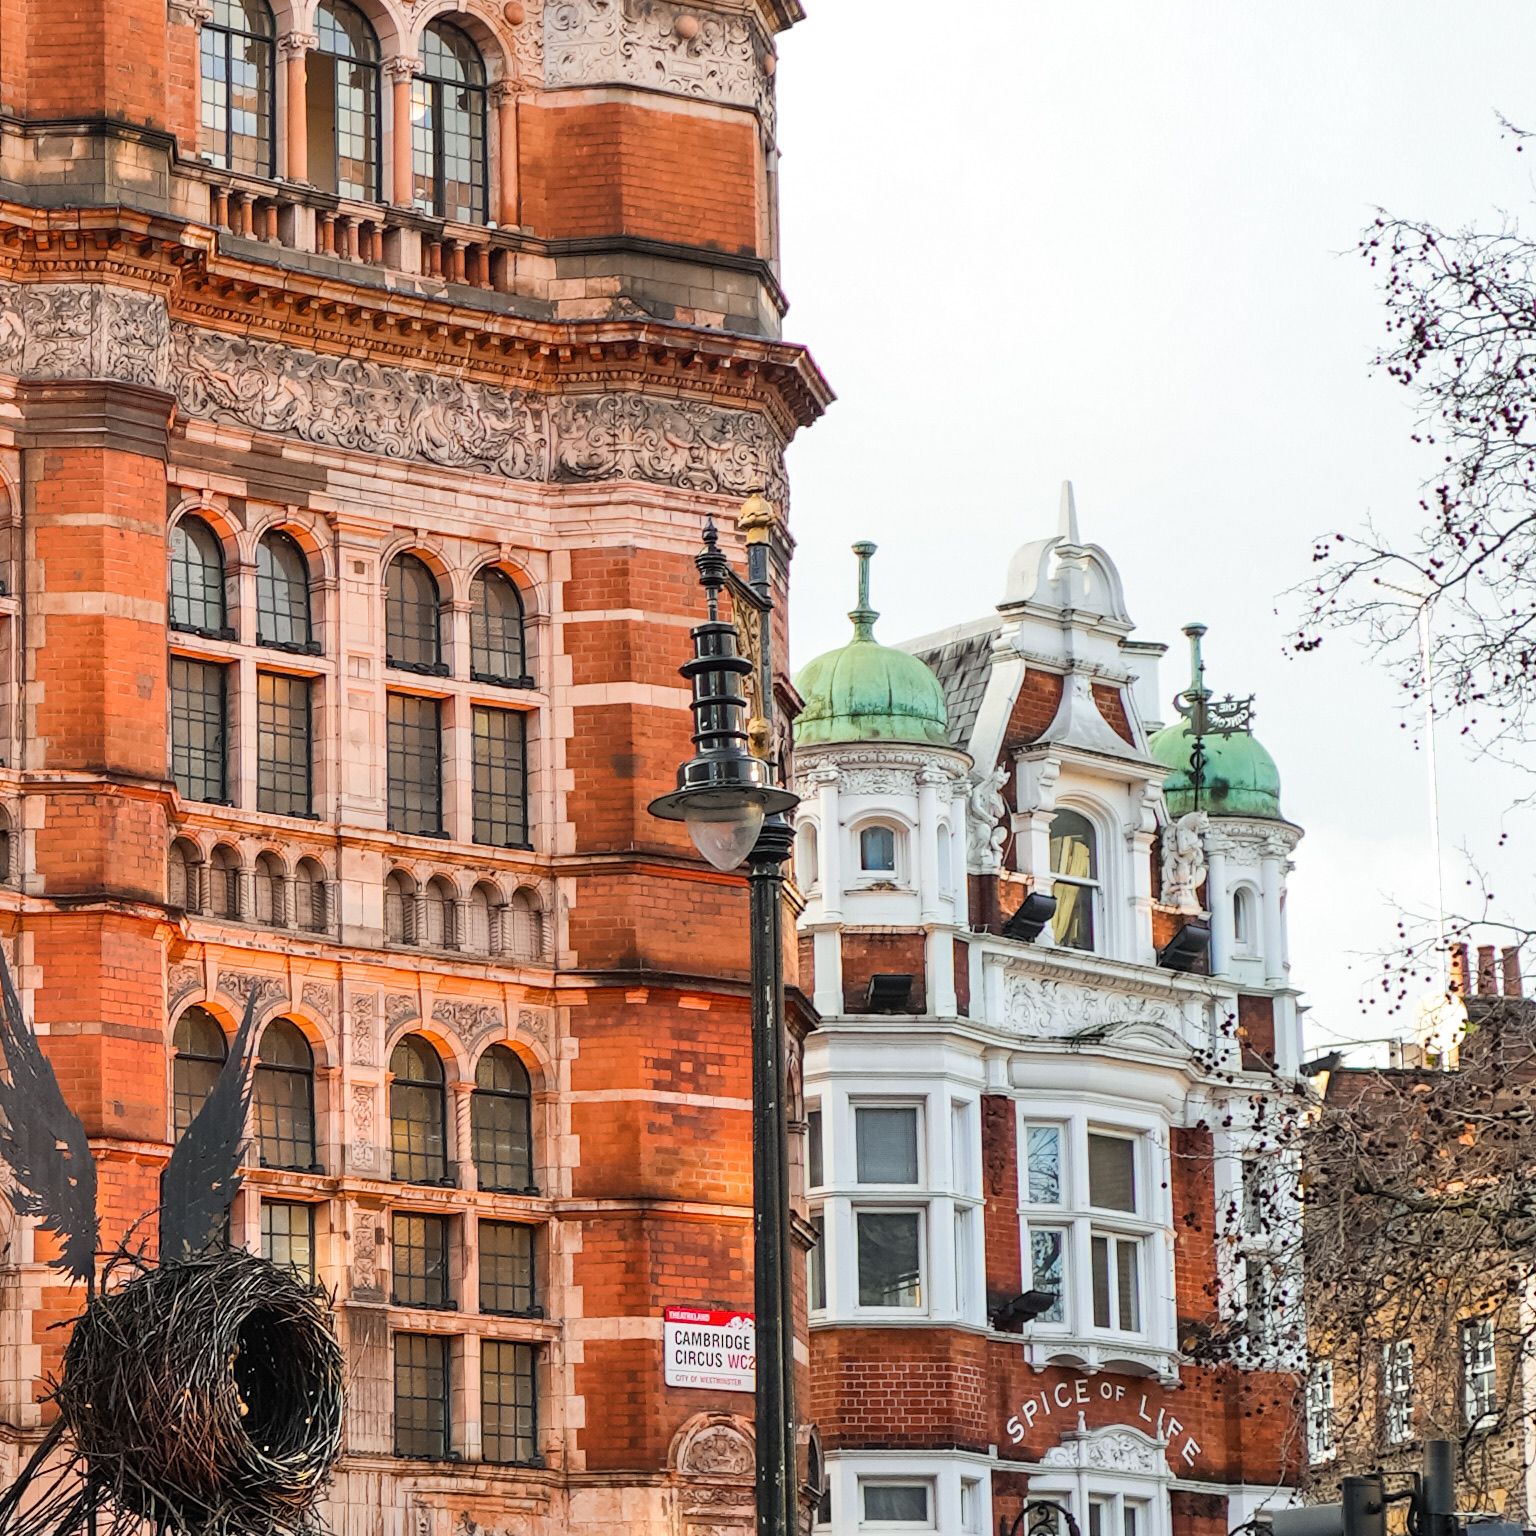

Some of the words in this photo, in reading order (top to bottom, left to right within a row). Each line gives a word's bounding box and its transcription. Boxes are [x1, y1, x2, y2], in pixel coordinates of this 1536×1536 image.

[675, 1330, 751, 1351] CAMBRIDGE
[675, 1349, 723, 1368] CIRCUS
[728, 1354, 756, 1371] WC2
[675, 1374, 688, 1382] CITY
[690, 1375, 697, 1383] OF
[700, 1376, 742, 1386] WESTMINSTER
[1006, 1379, 1091, 1444] SPICE
[1100, 1381, 1126, 1402] OF
[1139, 1394, 1202, 1467] LIFE
